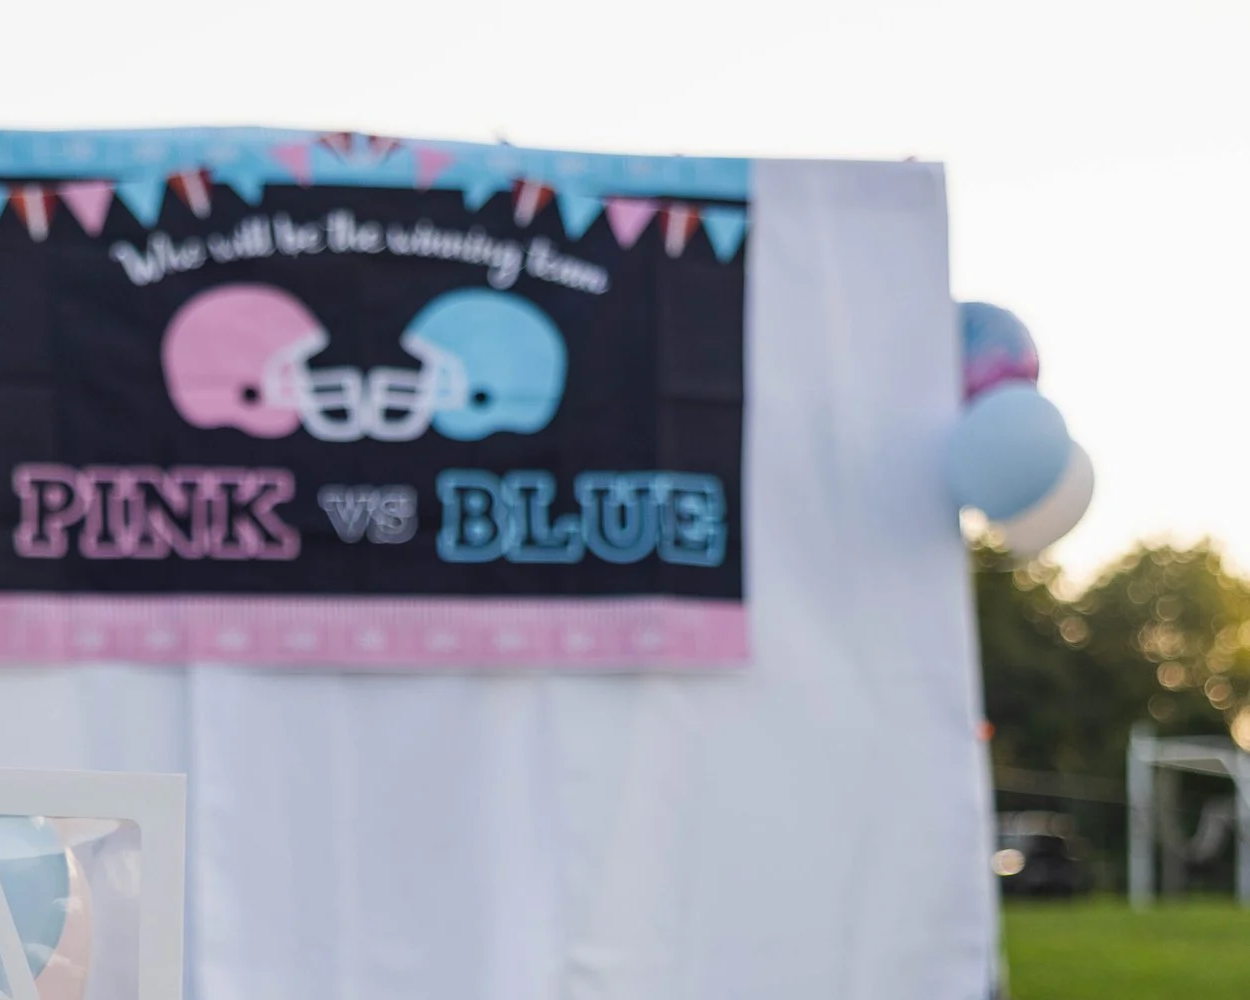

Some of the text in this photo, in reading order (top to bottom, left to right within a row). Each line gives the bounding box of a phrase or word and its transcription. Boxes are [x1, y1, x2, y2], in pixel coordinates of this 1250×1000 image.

[110, 207, 610, 295] Who will be the winning team
[13, 463, 300, 560] PINK
[436, 468, 726, 567] BLUE
